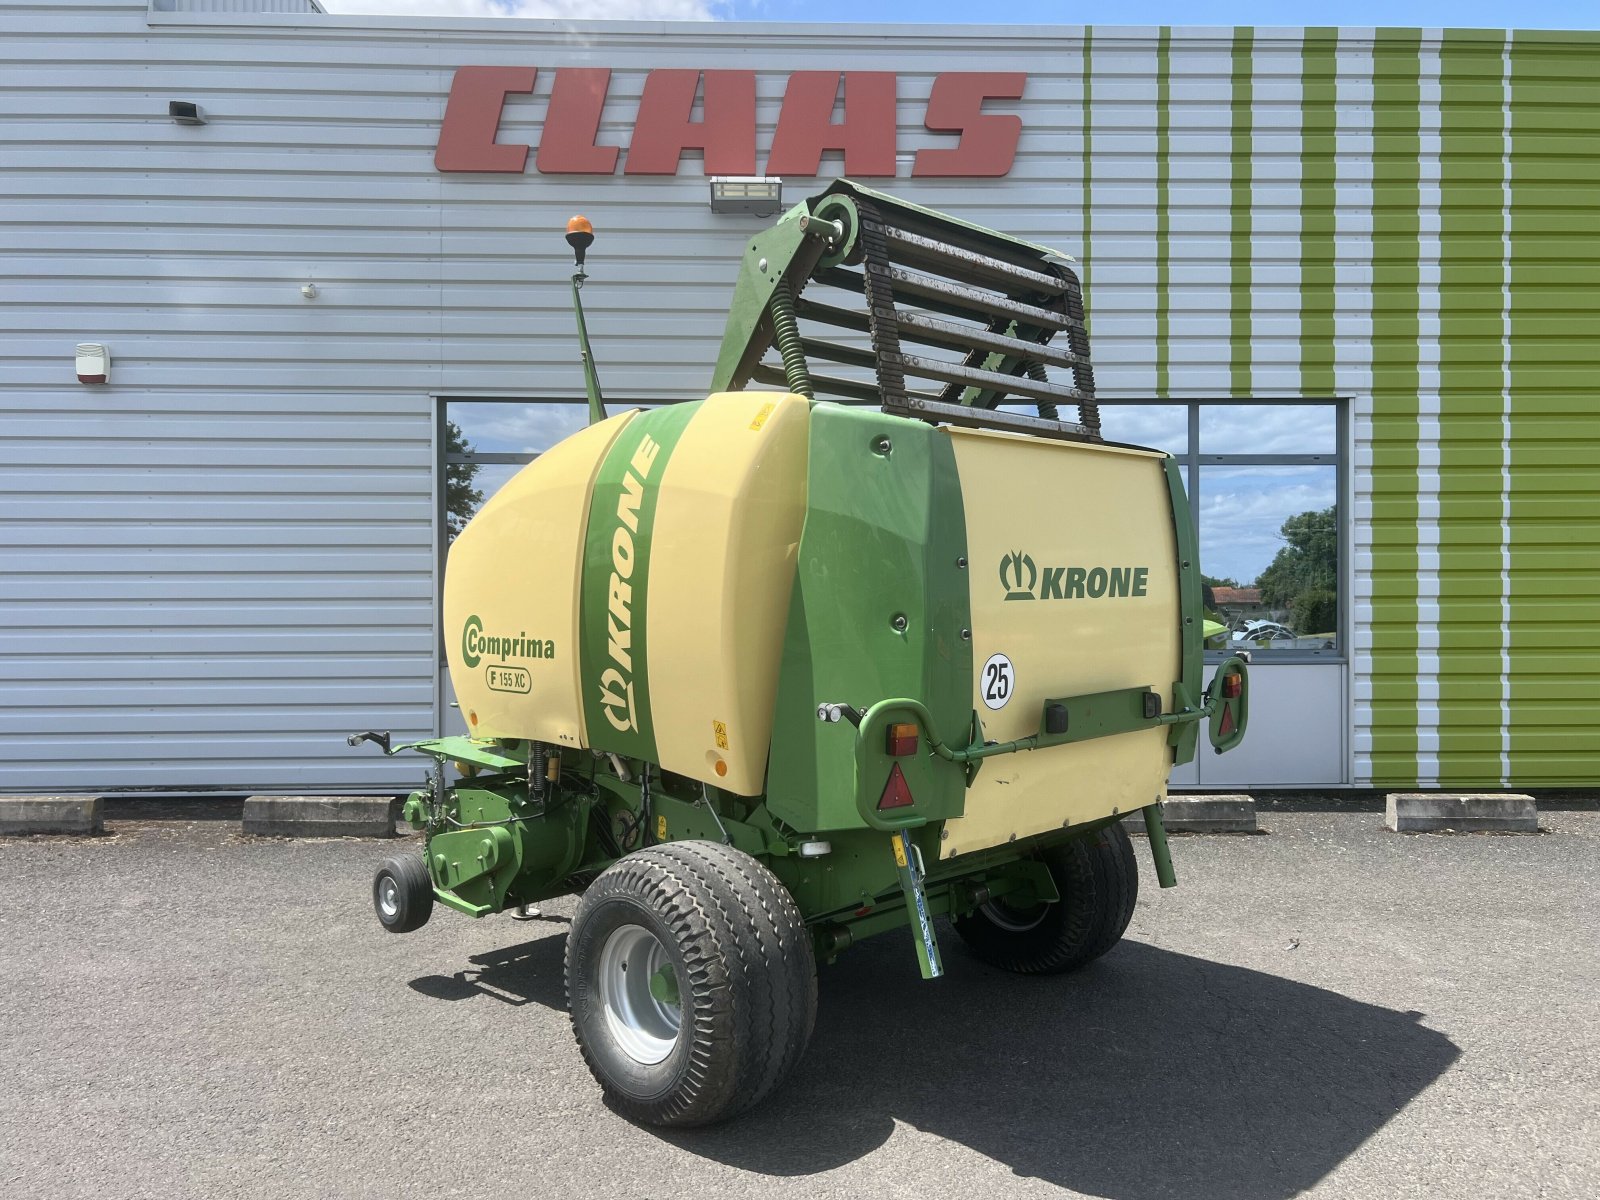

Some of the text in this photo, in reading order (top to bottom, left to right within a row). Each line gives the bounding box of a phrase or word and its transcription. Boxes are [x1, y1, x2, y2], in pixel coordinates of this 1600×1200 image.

[435, 65, 1027, 178] CLAAS
[608, 433, 661, 674] KRONE
[1040, 567, 1149, 599] KRONE
[462, 615, 555, 668] Comprima
[490, 671, 526, 688] F 155 XC
[986, 663, 1009, 701] 25
